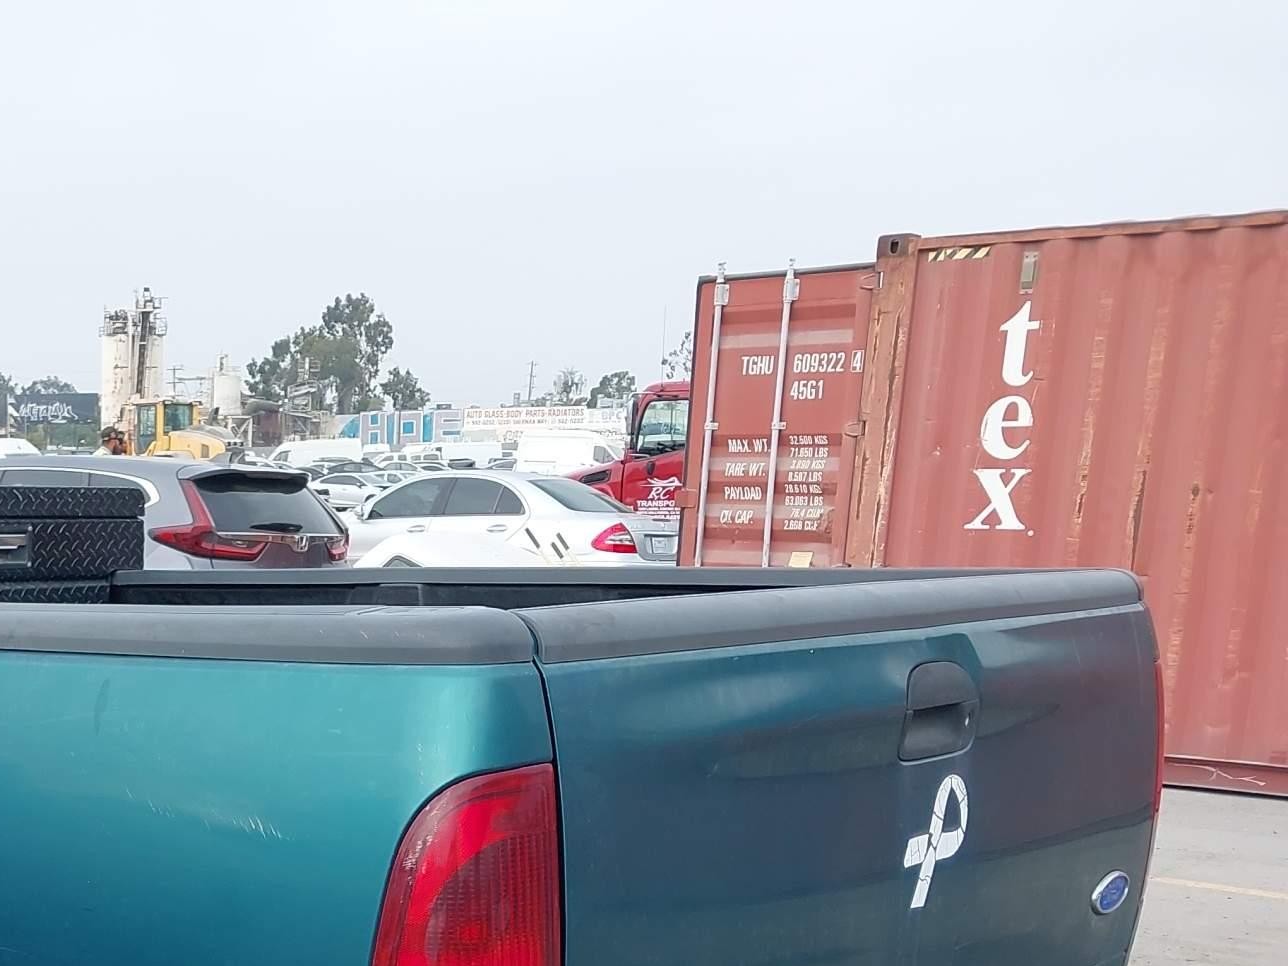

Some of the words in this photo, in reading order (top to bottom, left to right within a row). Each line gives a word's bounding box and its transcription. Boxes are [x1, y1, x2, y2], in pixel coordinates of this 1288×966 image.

[741, 355, 775, 376] TGHU
[793, 351, 846, 373] 609322
[851, 350, 864, 372] 4
[790, 379, 824, 400] 45G1
[728, 439, 752, 453] MAX.
[753, 439, 771, 452] WT.
[814, 435, 829, 445] KGS
[814, 447, 829, 458] LBS
[724, 462, 746, 476] TARE
[748, 463, 767, 476] WT.
[808, 471, 823, 482] LBS
[724, 486, 762, 500] PAYLOAD
[809, 496, 824, 506] LBS
[734, 510, 754, 524] CAP.
